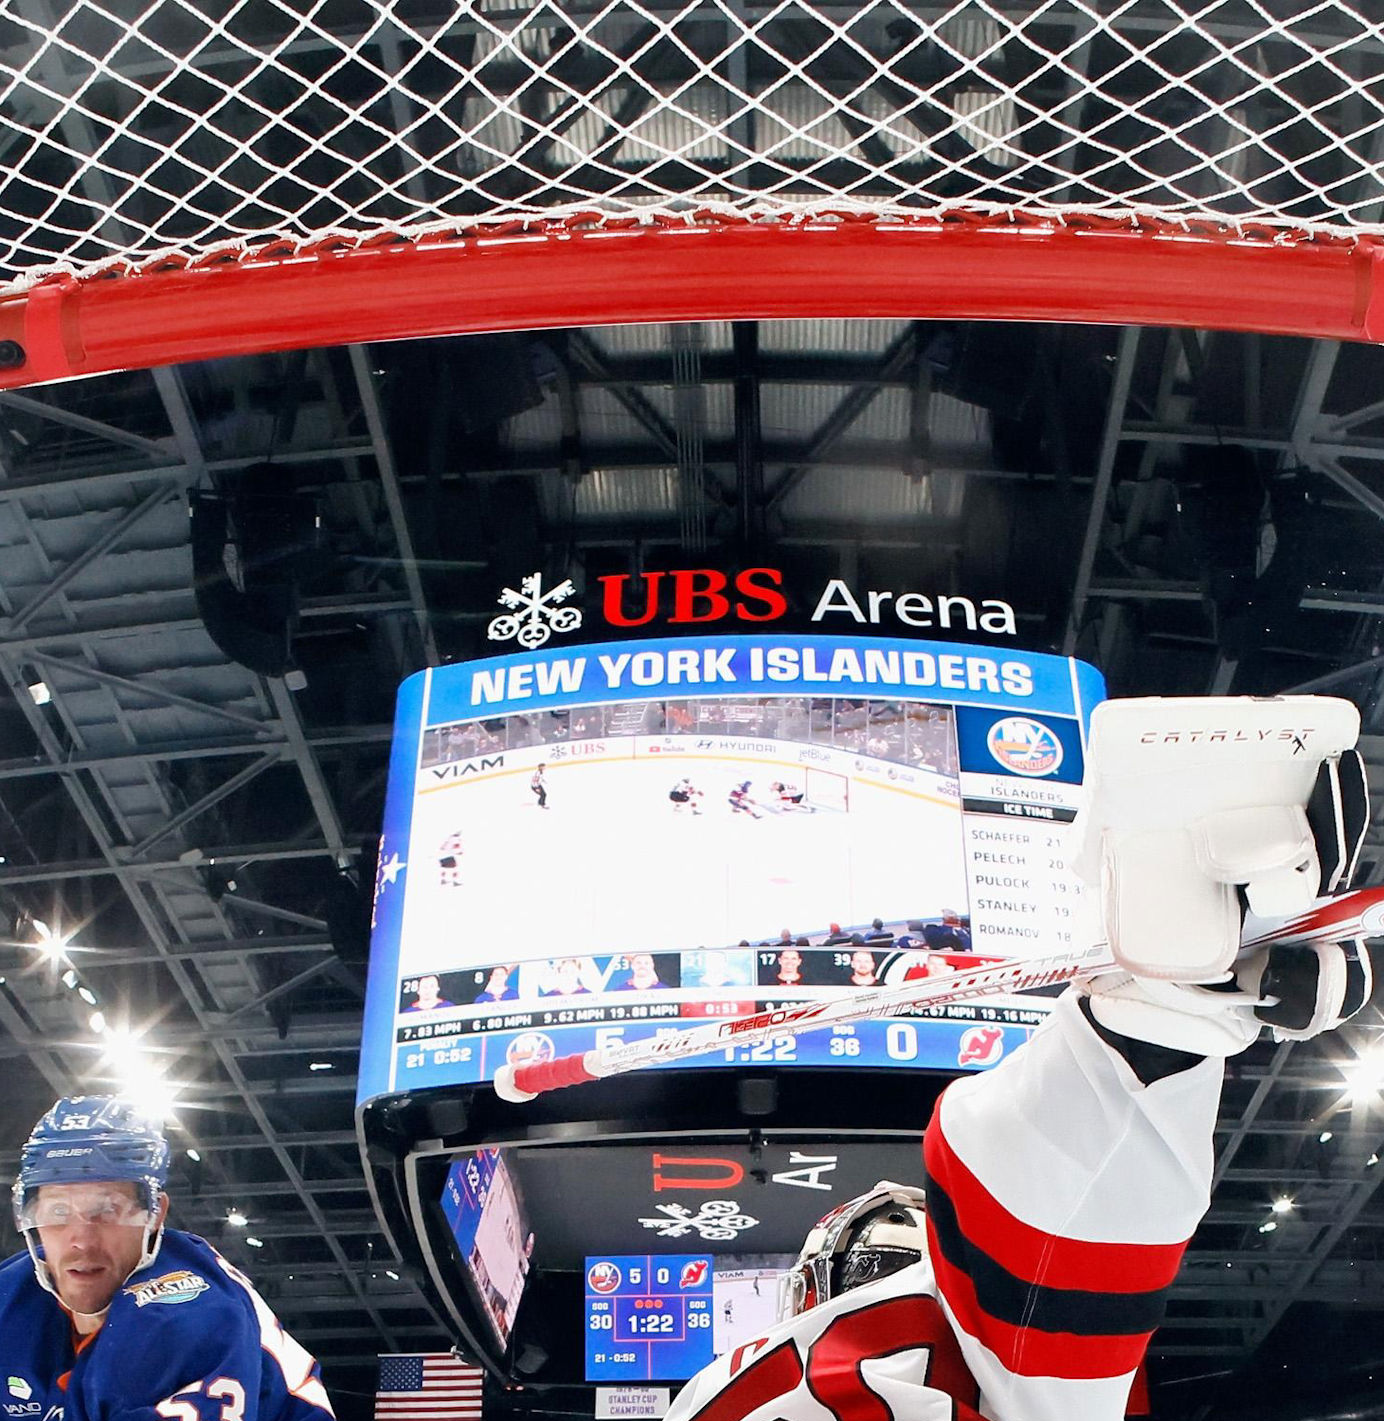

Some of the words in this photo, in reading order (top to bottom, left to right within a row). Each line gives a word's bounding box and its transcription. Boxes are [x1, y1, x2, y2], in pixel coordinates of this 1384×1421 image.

[598, 568, 786, 625] UBS
[812, 579, 1016, 635] Arena
[470, 658, 585, 705] NEW
[589, 650, 736, 692] YORK
[748, 647, 1033, 698] ISLANDERS
[1141, 728, 1316, 746] CATALYST
[571, 743, 605, 756] UBS
[432, 755, 504, 780] VIAM
[991, 786, 1064, 803] ISLANDERS
[1003, 803, 1022, 815] ICE
[1025, 806, 1054, 819] TIME
[971, 829, 1031, 844] SCHAEFER
[974, 852, 1026, 865] PELECH
[976, 875, 1031, 889] PULOCK
[977, 899, 1037, 913] STANLEY
[979, 924, 1040, 939] ROMANOV
[760, 953, 776, 966] 17
[833, 953, 851, 967] 39
[474, 971, 484, 984] 8
[576, 1009, 605, 1021] MPH
[649, 1004, 679, 1017] MPH
[947, 1008, 976, 1019] MPH
[504, 1014, 532, 1028] MPH
[1019, 1012, 1050, 1025] MPH
[434, 1022, 462, 1037] MPH
[887, 1023, 919, 1061] 0
[406, 1055, 425, 1068] 21
[61, 1114, 91, 1130] 53
[46, 1147, 93, 1159] BAUER
[629, 1267, 642, 1284] 5
[657, 1267, 669, 1284] 0
[589, 1314, 613, 1330] 30
[628, 1314, 674, 1333] 1:22
[687, 1312, 711, 1328] 36
[595, 1354, 606, 1363] 21
[608, 1395, 641, 1404] STANLEY
[642, 1394, 658, 1404] CUP
[609, 1405, 655, 1415] CHAMPIONS
